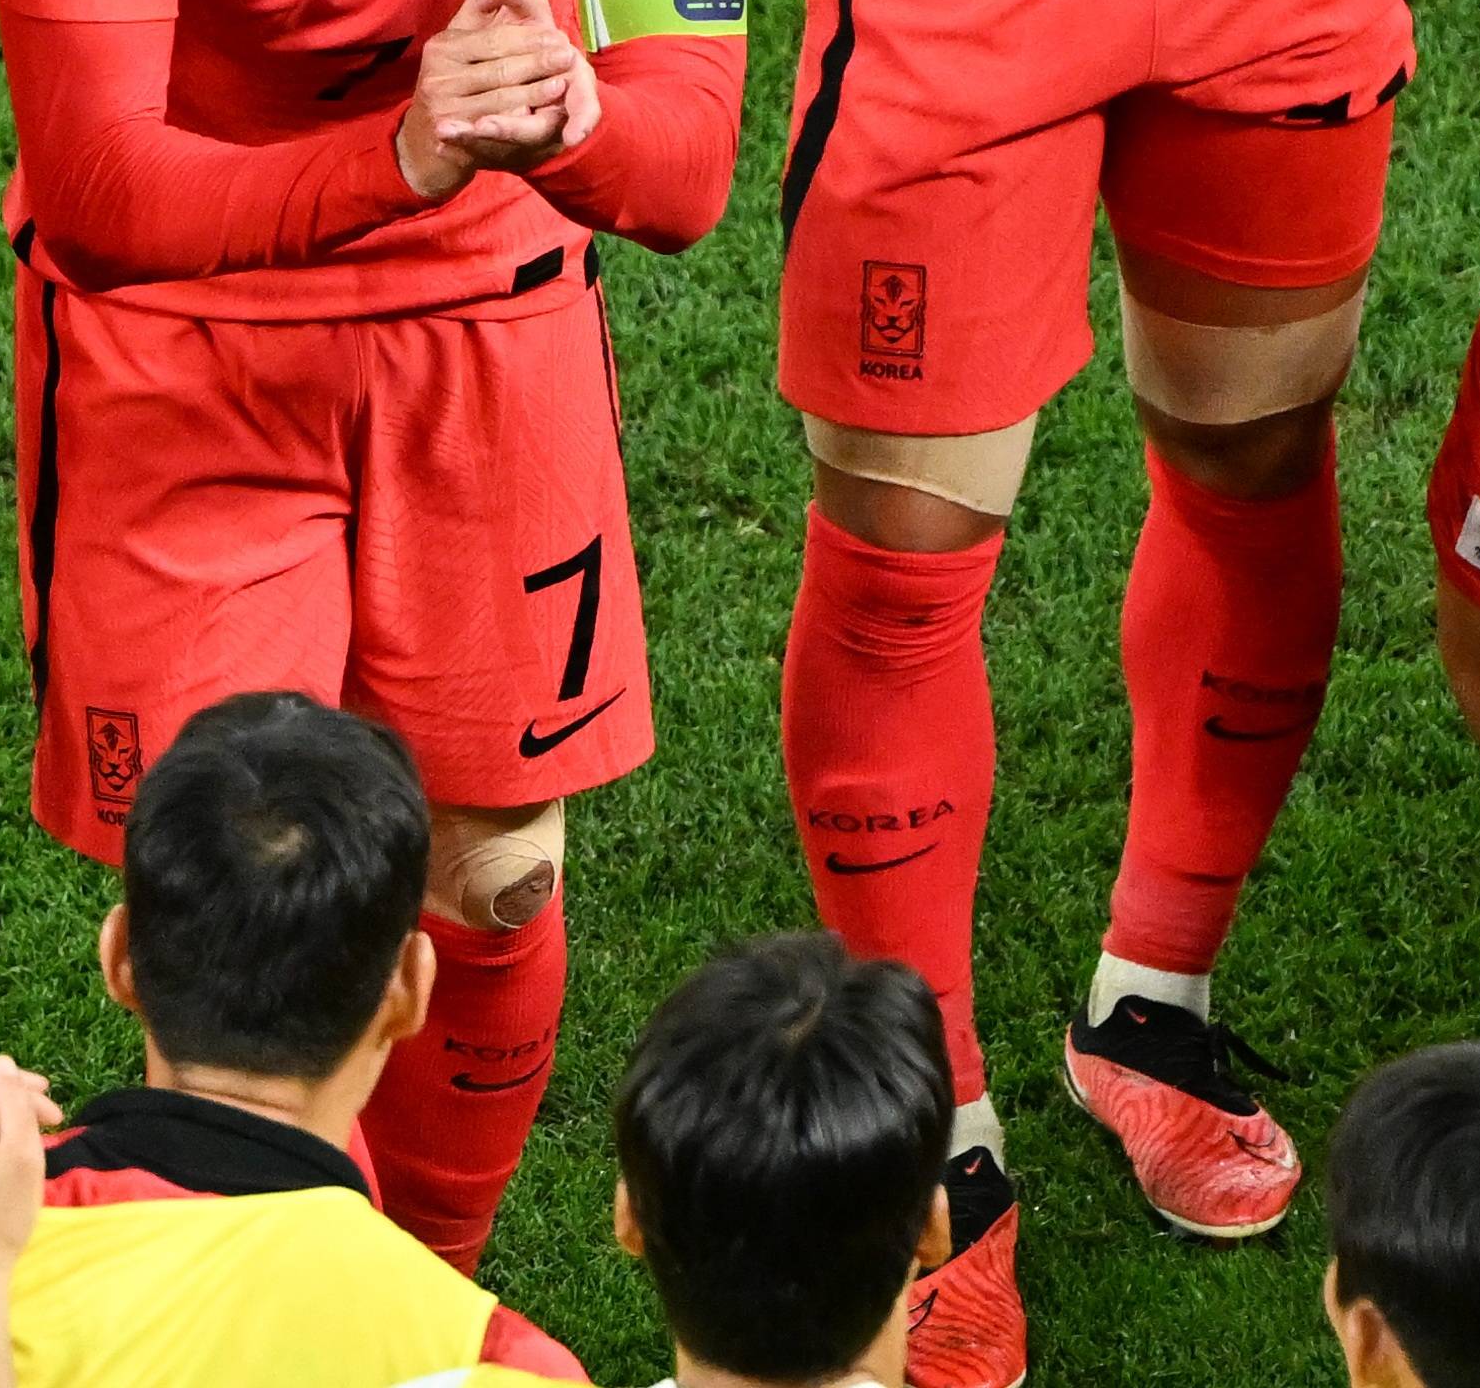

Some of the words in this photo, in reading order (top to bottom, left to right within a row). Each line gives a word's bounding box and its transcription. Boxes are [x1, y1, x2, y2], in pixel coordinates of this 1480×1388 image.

[859, 359, 924, 381] KOREA
[523, 533, 602, 702] 7
[808, 799, 955, 833] KOREA
